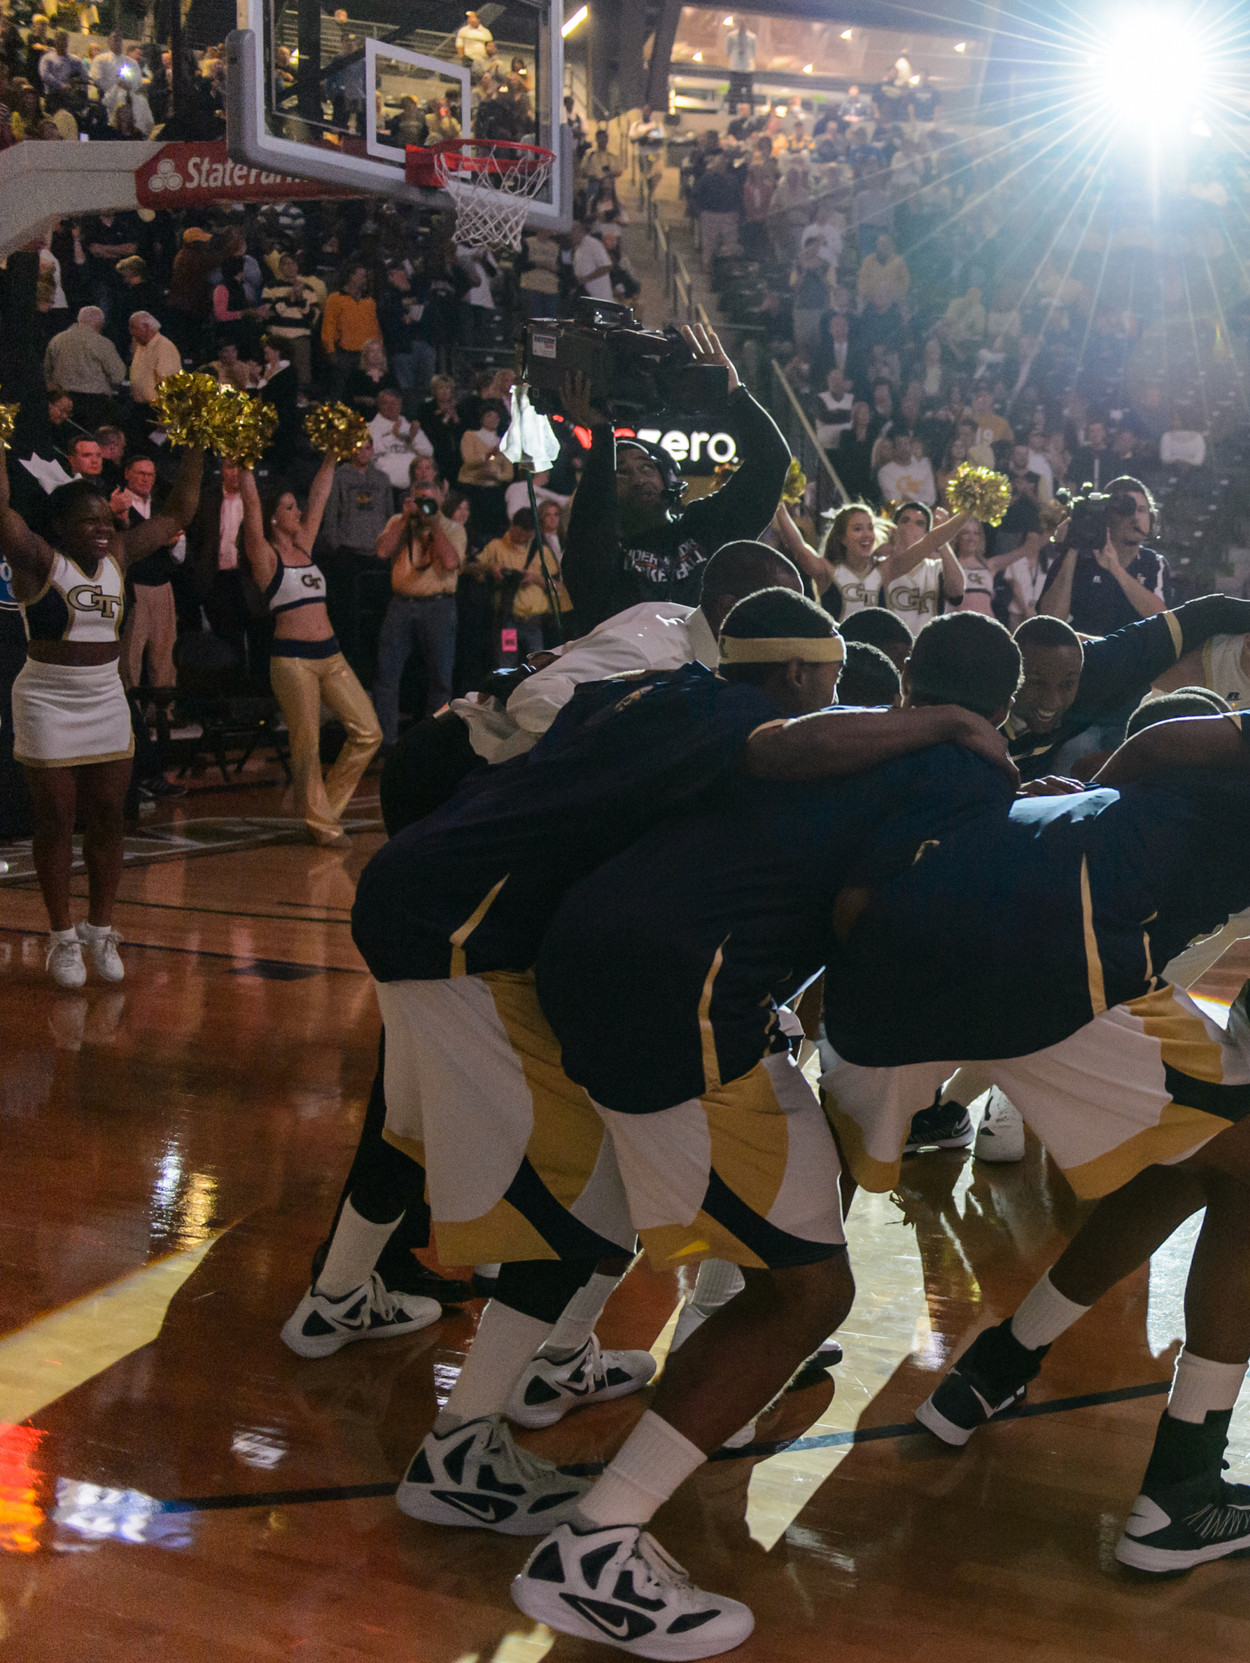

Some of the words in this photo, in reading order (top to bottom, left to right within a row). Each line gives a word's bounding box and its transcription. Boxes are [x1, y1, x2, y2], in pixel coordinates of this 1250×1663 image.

[301, 573, 322, 590] GT
[67, 584, 122, 618] GT
[842, 583, 879, 607] GT
[890, 586, 937, 615] GT
